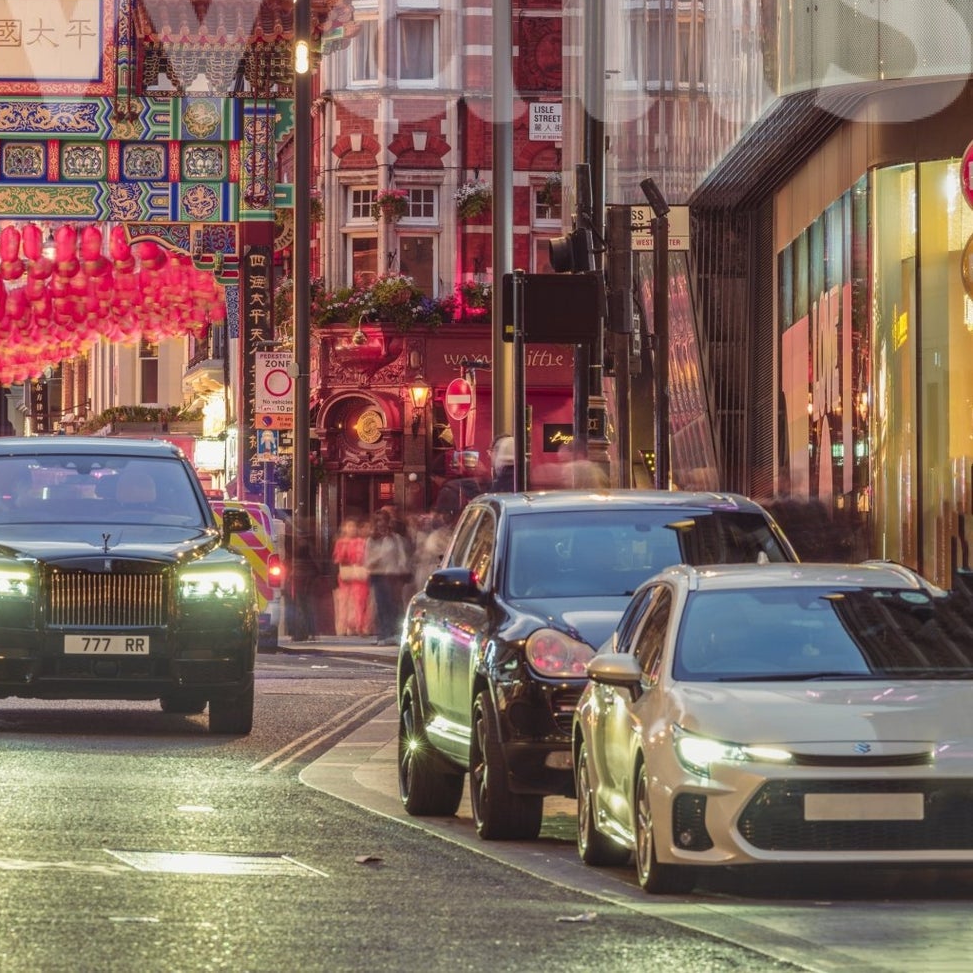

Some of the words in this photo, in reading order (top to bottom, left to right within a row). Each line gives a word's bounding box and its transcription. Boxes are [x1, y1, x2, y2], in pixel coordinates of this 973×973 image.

[534, 106, 554, 114] LISLE
[534, 115, 561, 123] STREET
[525, 350, 564, 366] ittle
[81, 637, 112, 652] 777
[125, 637, 145, 652] RR
